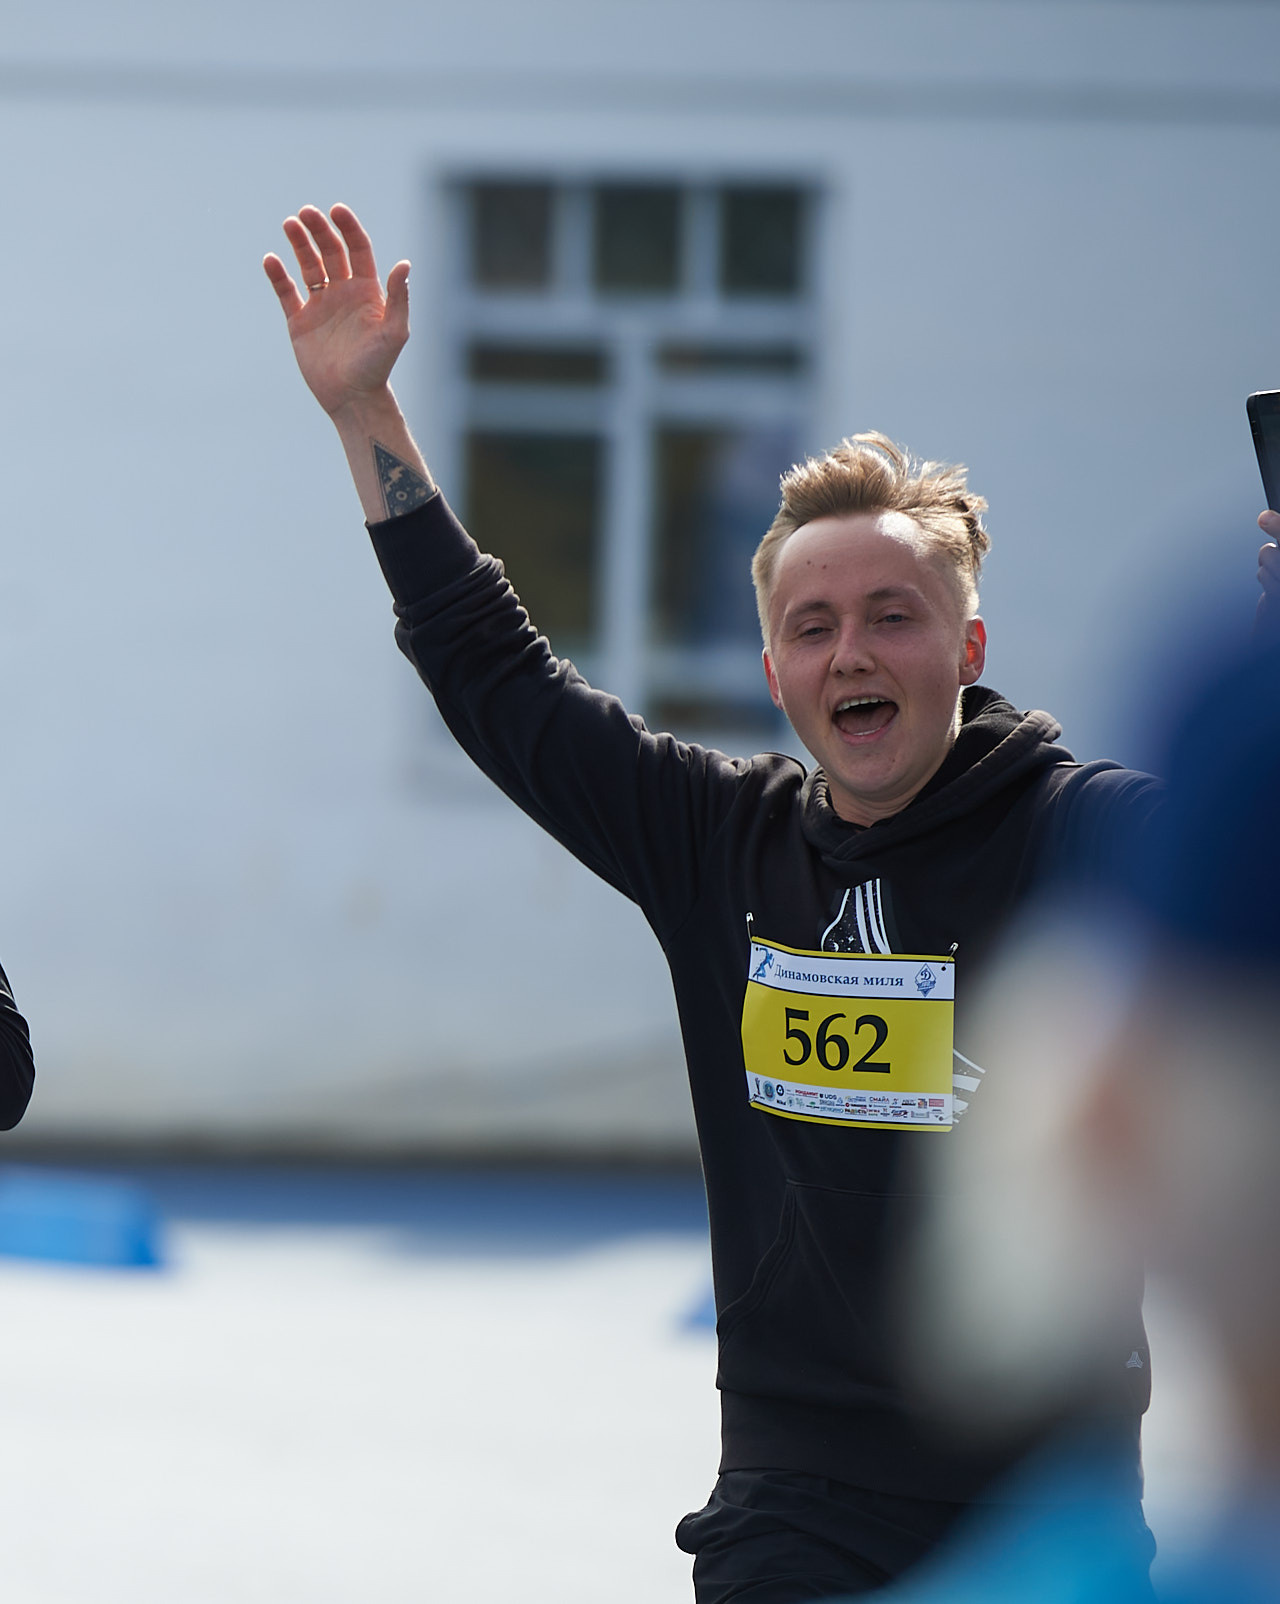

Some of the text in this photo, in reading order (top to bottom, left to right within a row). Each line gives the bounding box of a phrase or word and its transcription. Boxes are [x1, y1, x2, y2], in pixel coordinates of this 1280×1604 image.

[774, 963, 859, 986] Динамовская
[863, 976, 904, 987] миля
[783, 1007, 891, 1074] 562
